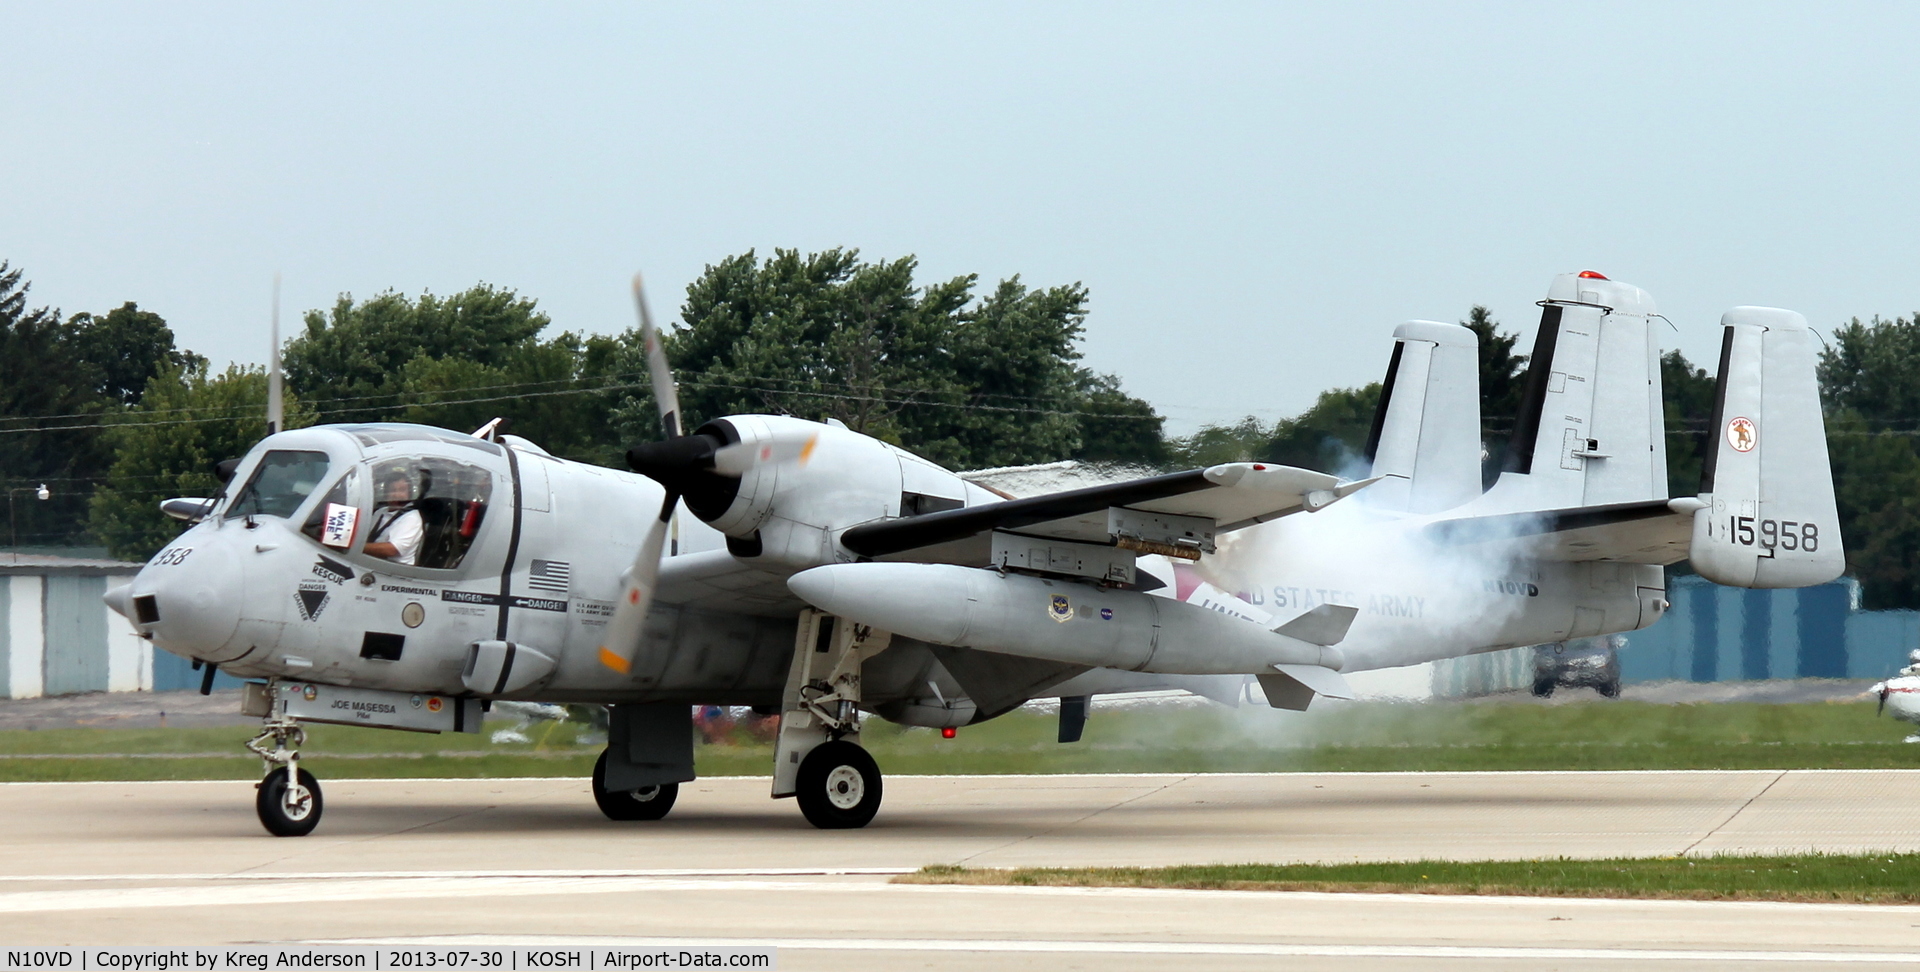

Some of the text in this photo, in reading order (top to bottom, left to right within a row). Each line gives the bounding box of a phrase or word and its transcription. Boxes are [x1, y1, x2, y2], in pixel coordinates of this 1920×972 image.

[326, 516, 338, 533] ME
[333, 511, 347, 541] WALK
[153, 547, 193, 566] 958
[312, 565, 345, 586] RESCUE
[381, 584, 438, 597] EXPERIMENTAL
[443, 591, 483, 603] DANGER
[1481, 579, 1539, 597] N10VD
[293, 593, 309, 621] DANGER
[312, 595, 331, 623] DANGER
[527, 598, 565, 611] DANGER
[1367, 593, 1426, 618] ARMY
[331, 699, 397, 714] JOE MASESSA
[357, 711, 371, 720] Pilot
